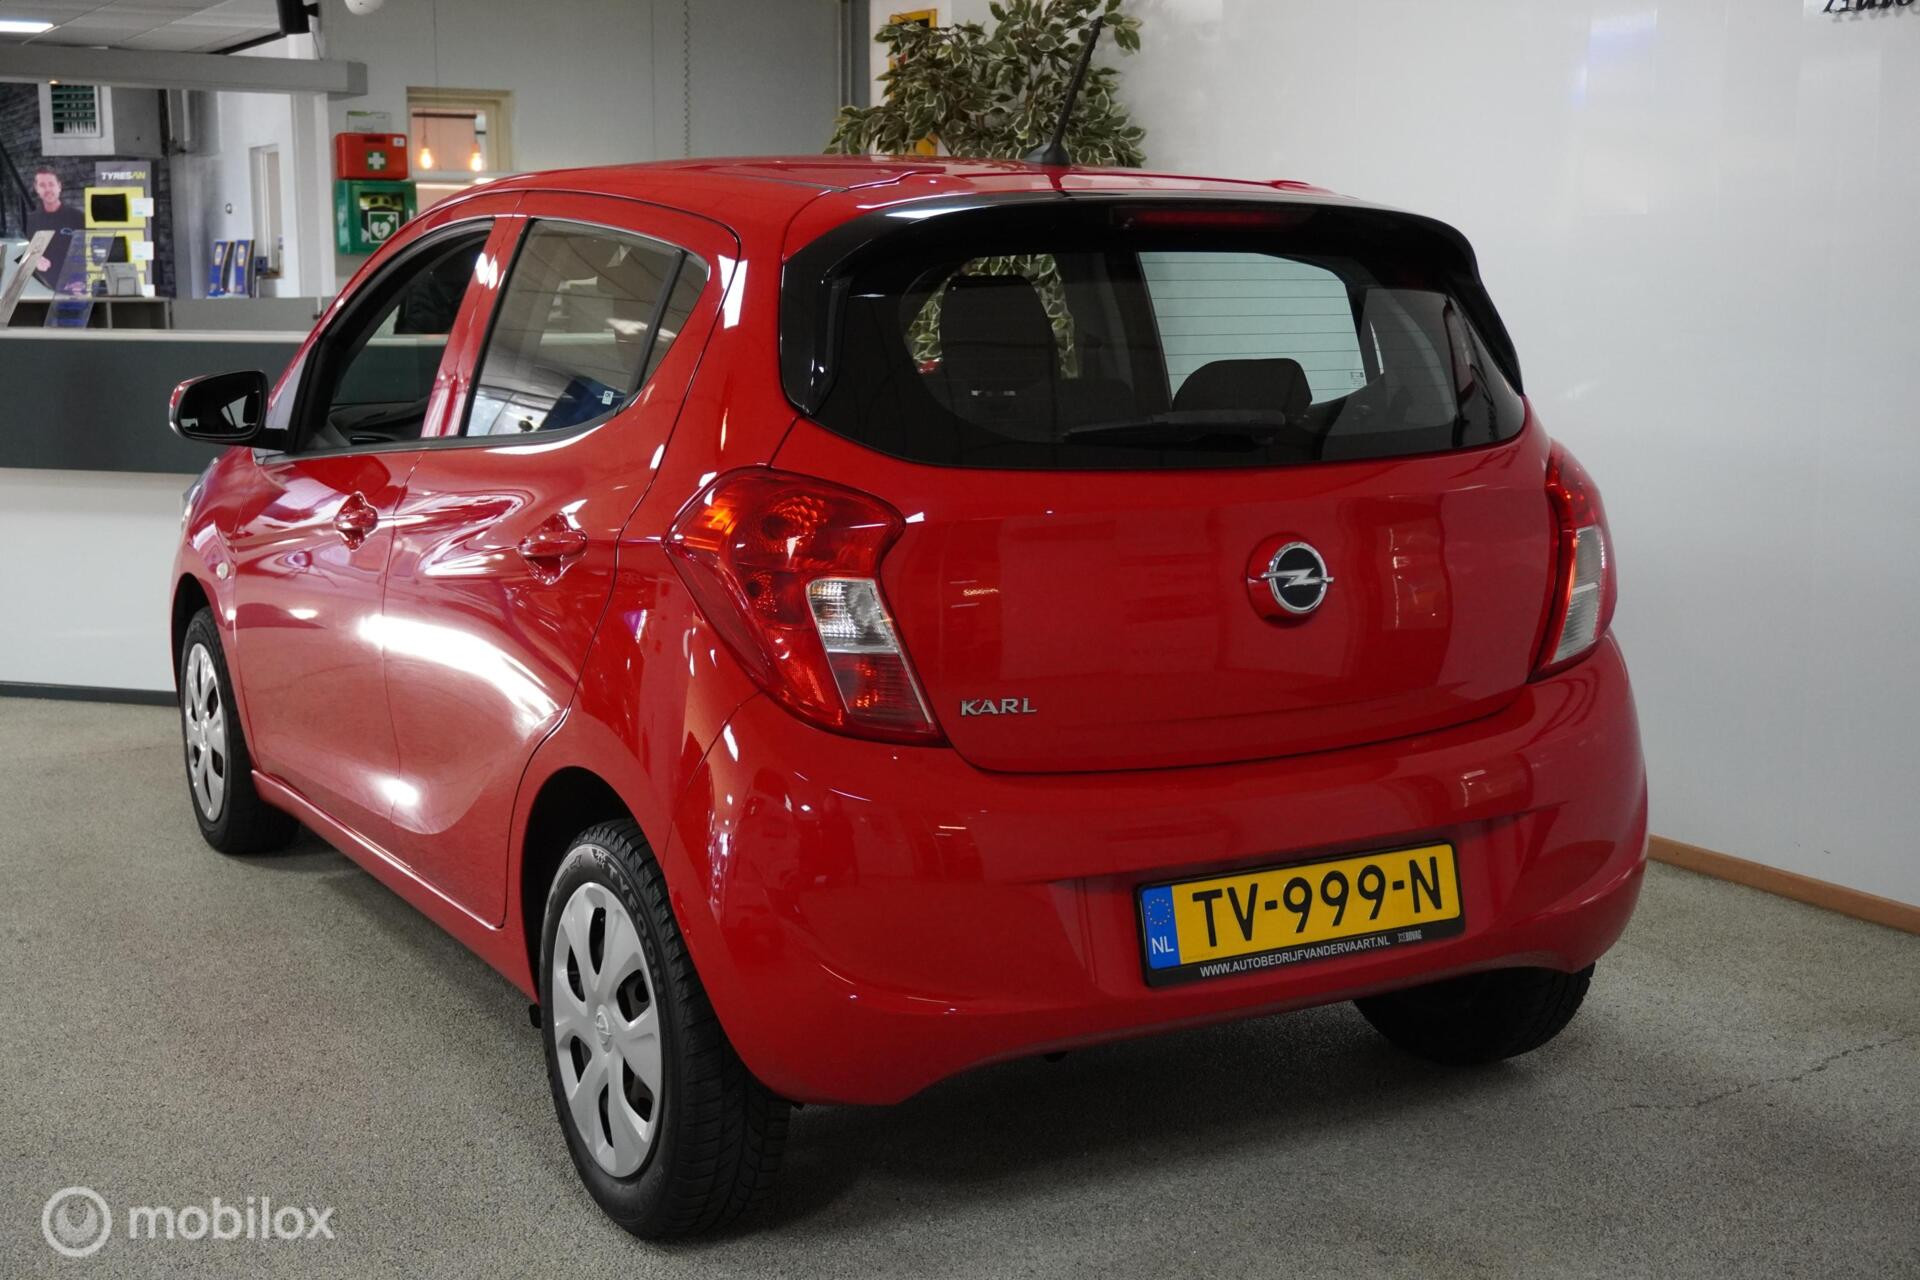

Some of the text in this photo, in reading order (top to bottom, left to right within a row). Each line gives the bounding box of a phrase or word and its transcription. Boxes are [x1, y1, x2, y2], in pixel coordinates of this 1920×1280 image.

[961, 697, 1037, 716] KARL
[1192, 856, 1442, 947] TV-999-N
[1151, 937, 1175, 955] NL
[1200, 936, 1390, 977] WWW.AUTOBEDRIJFVANDERVAART.NL
